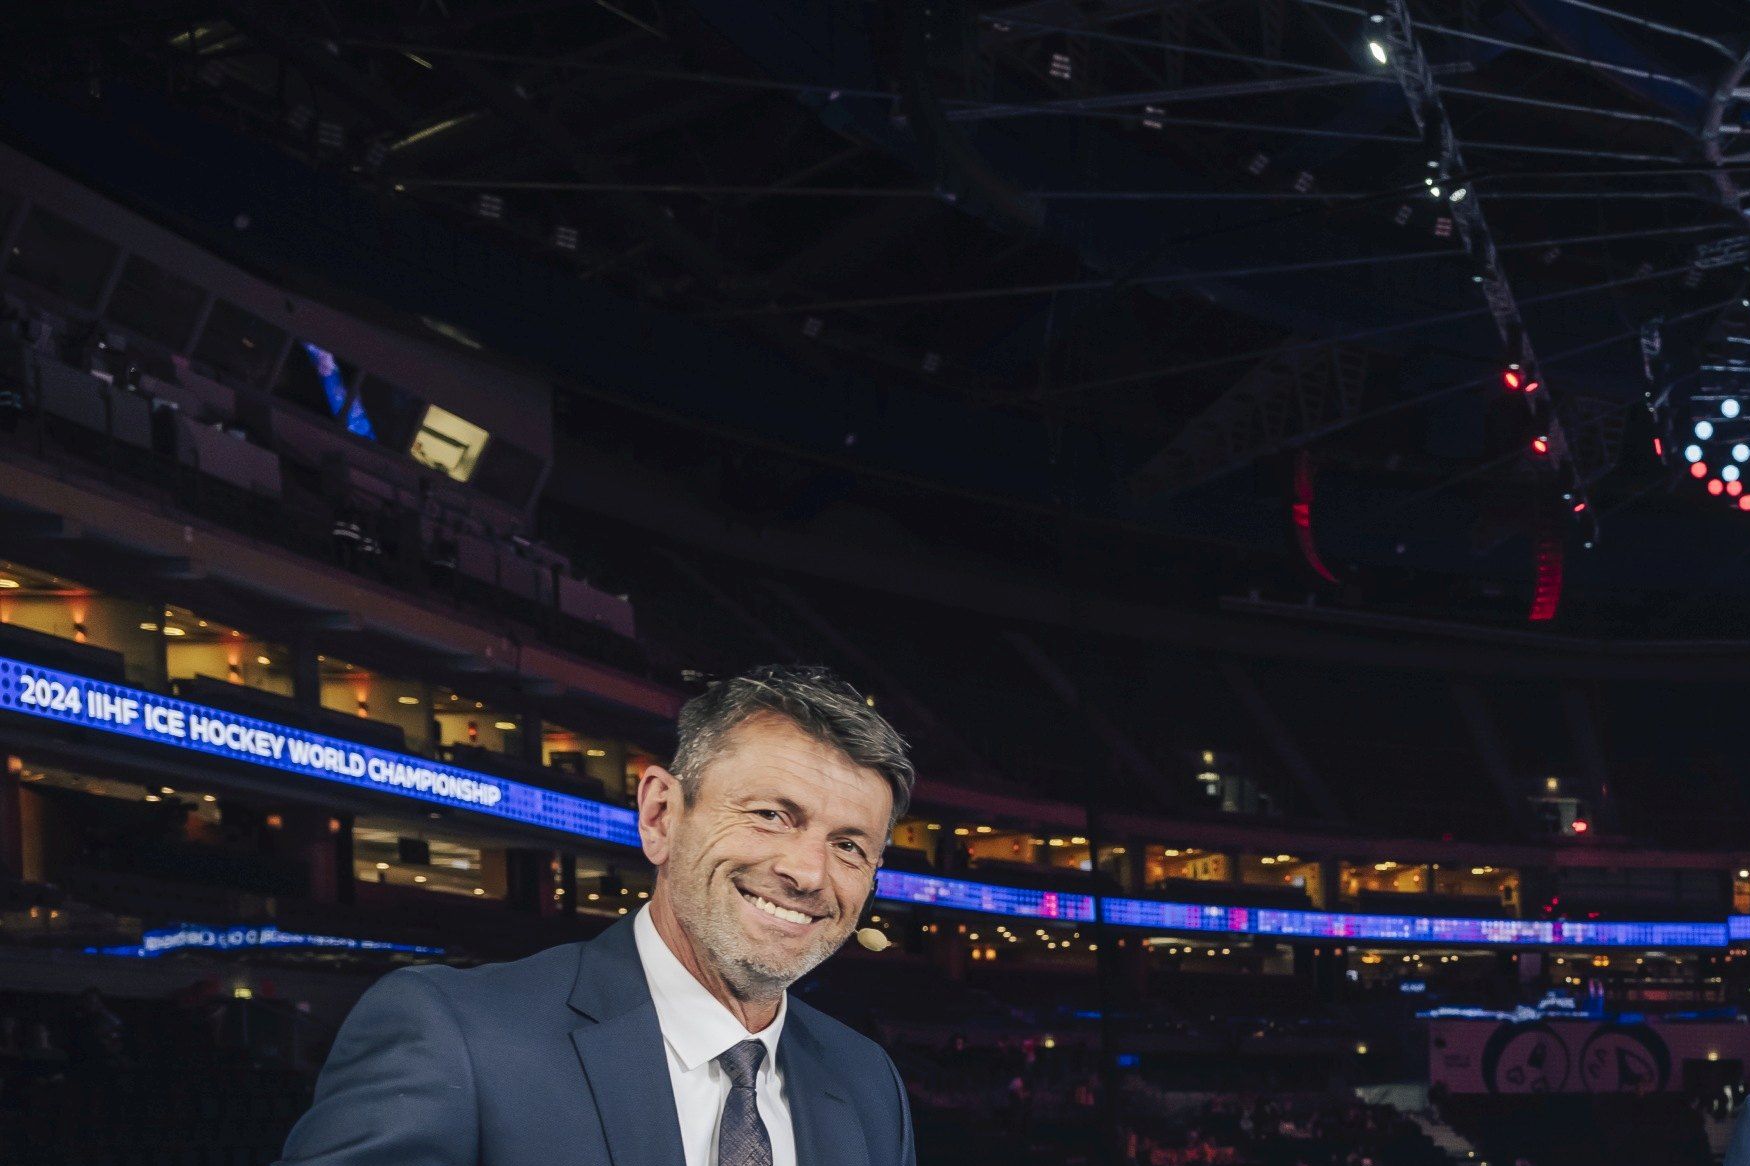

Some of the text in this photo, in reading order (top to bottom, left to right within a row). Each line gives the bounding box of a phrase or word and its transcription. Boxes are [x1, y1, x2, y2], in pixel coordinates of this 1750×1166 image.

[19, 674, 503, 807] 2024 IIHF ICE HOCKEY WORLD CHAMPIONSHIP
